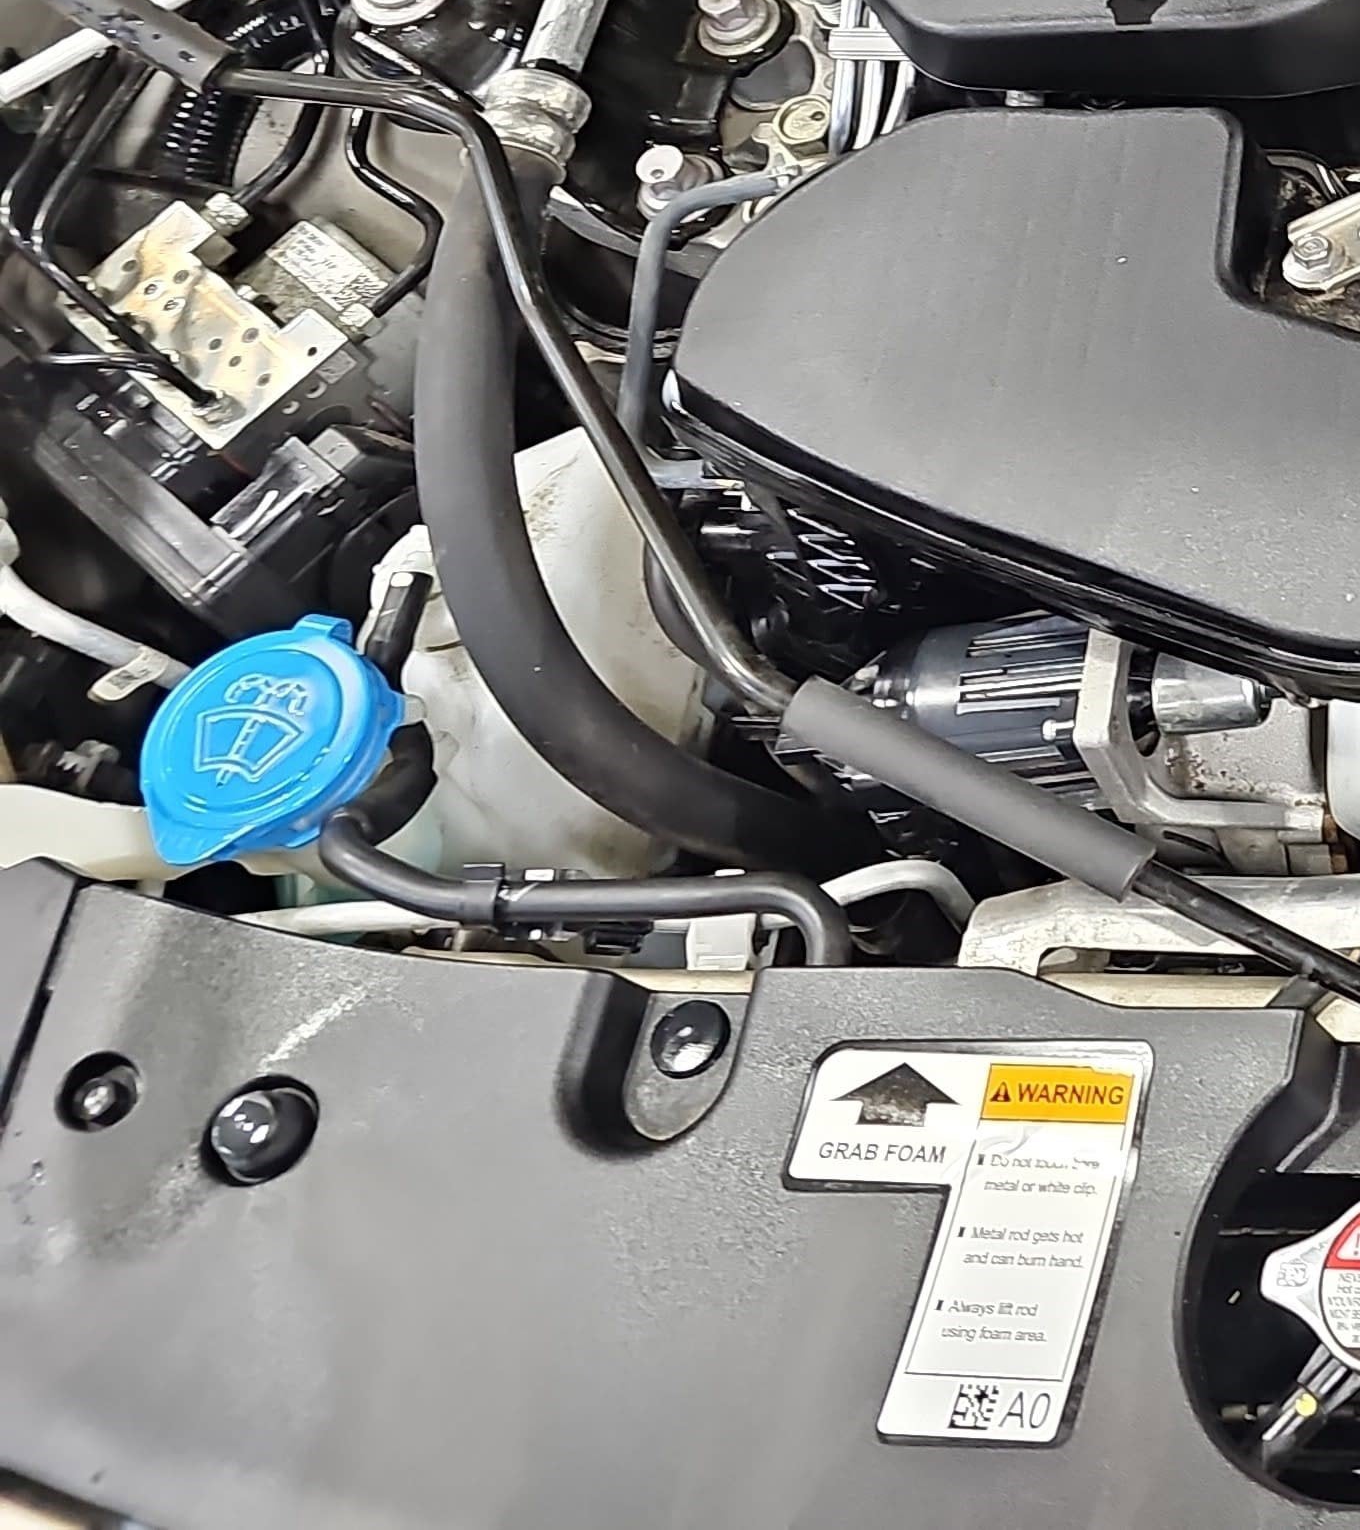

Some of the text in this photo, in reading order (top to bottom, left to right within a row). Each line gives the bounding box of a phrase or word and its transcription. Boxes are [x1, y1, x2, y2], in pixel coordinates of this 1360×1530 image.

[1018, 1083, 1124, 1105] WARNING
[819, 1142, 947, 1163] GRAB FOAM
[990, 1154, 1008, 1166] Do
[1013, 1156, 1031, 1167] not
[984, 1179, 1019, 1191] metal
[1022, 1183, 1035, 1192] or
[1038, 1182, 1070, 1194] white
[971, 1227, 1083, 1244] Metal rod gets hot
[963, 1252, 1083, 1268] and can burn hand.
[949, 1301, 1038, 1317] Always lift rod
[941, 1327, 1047, 1342] using foam area.
[999, 1391, 1050, 1429] A0
